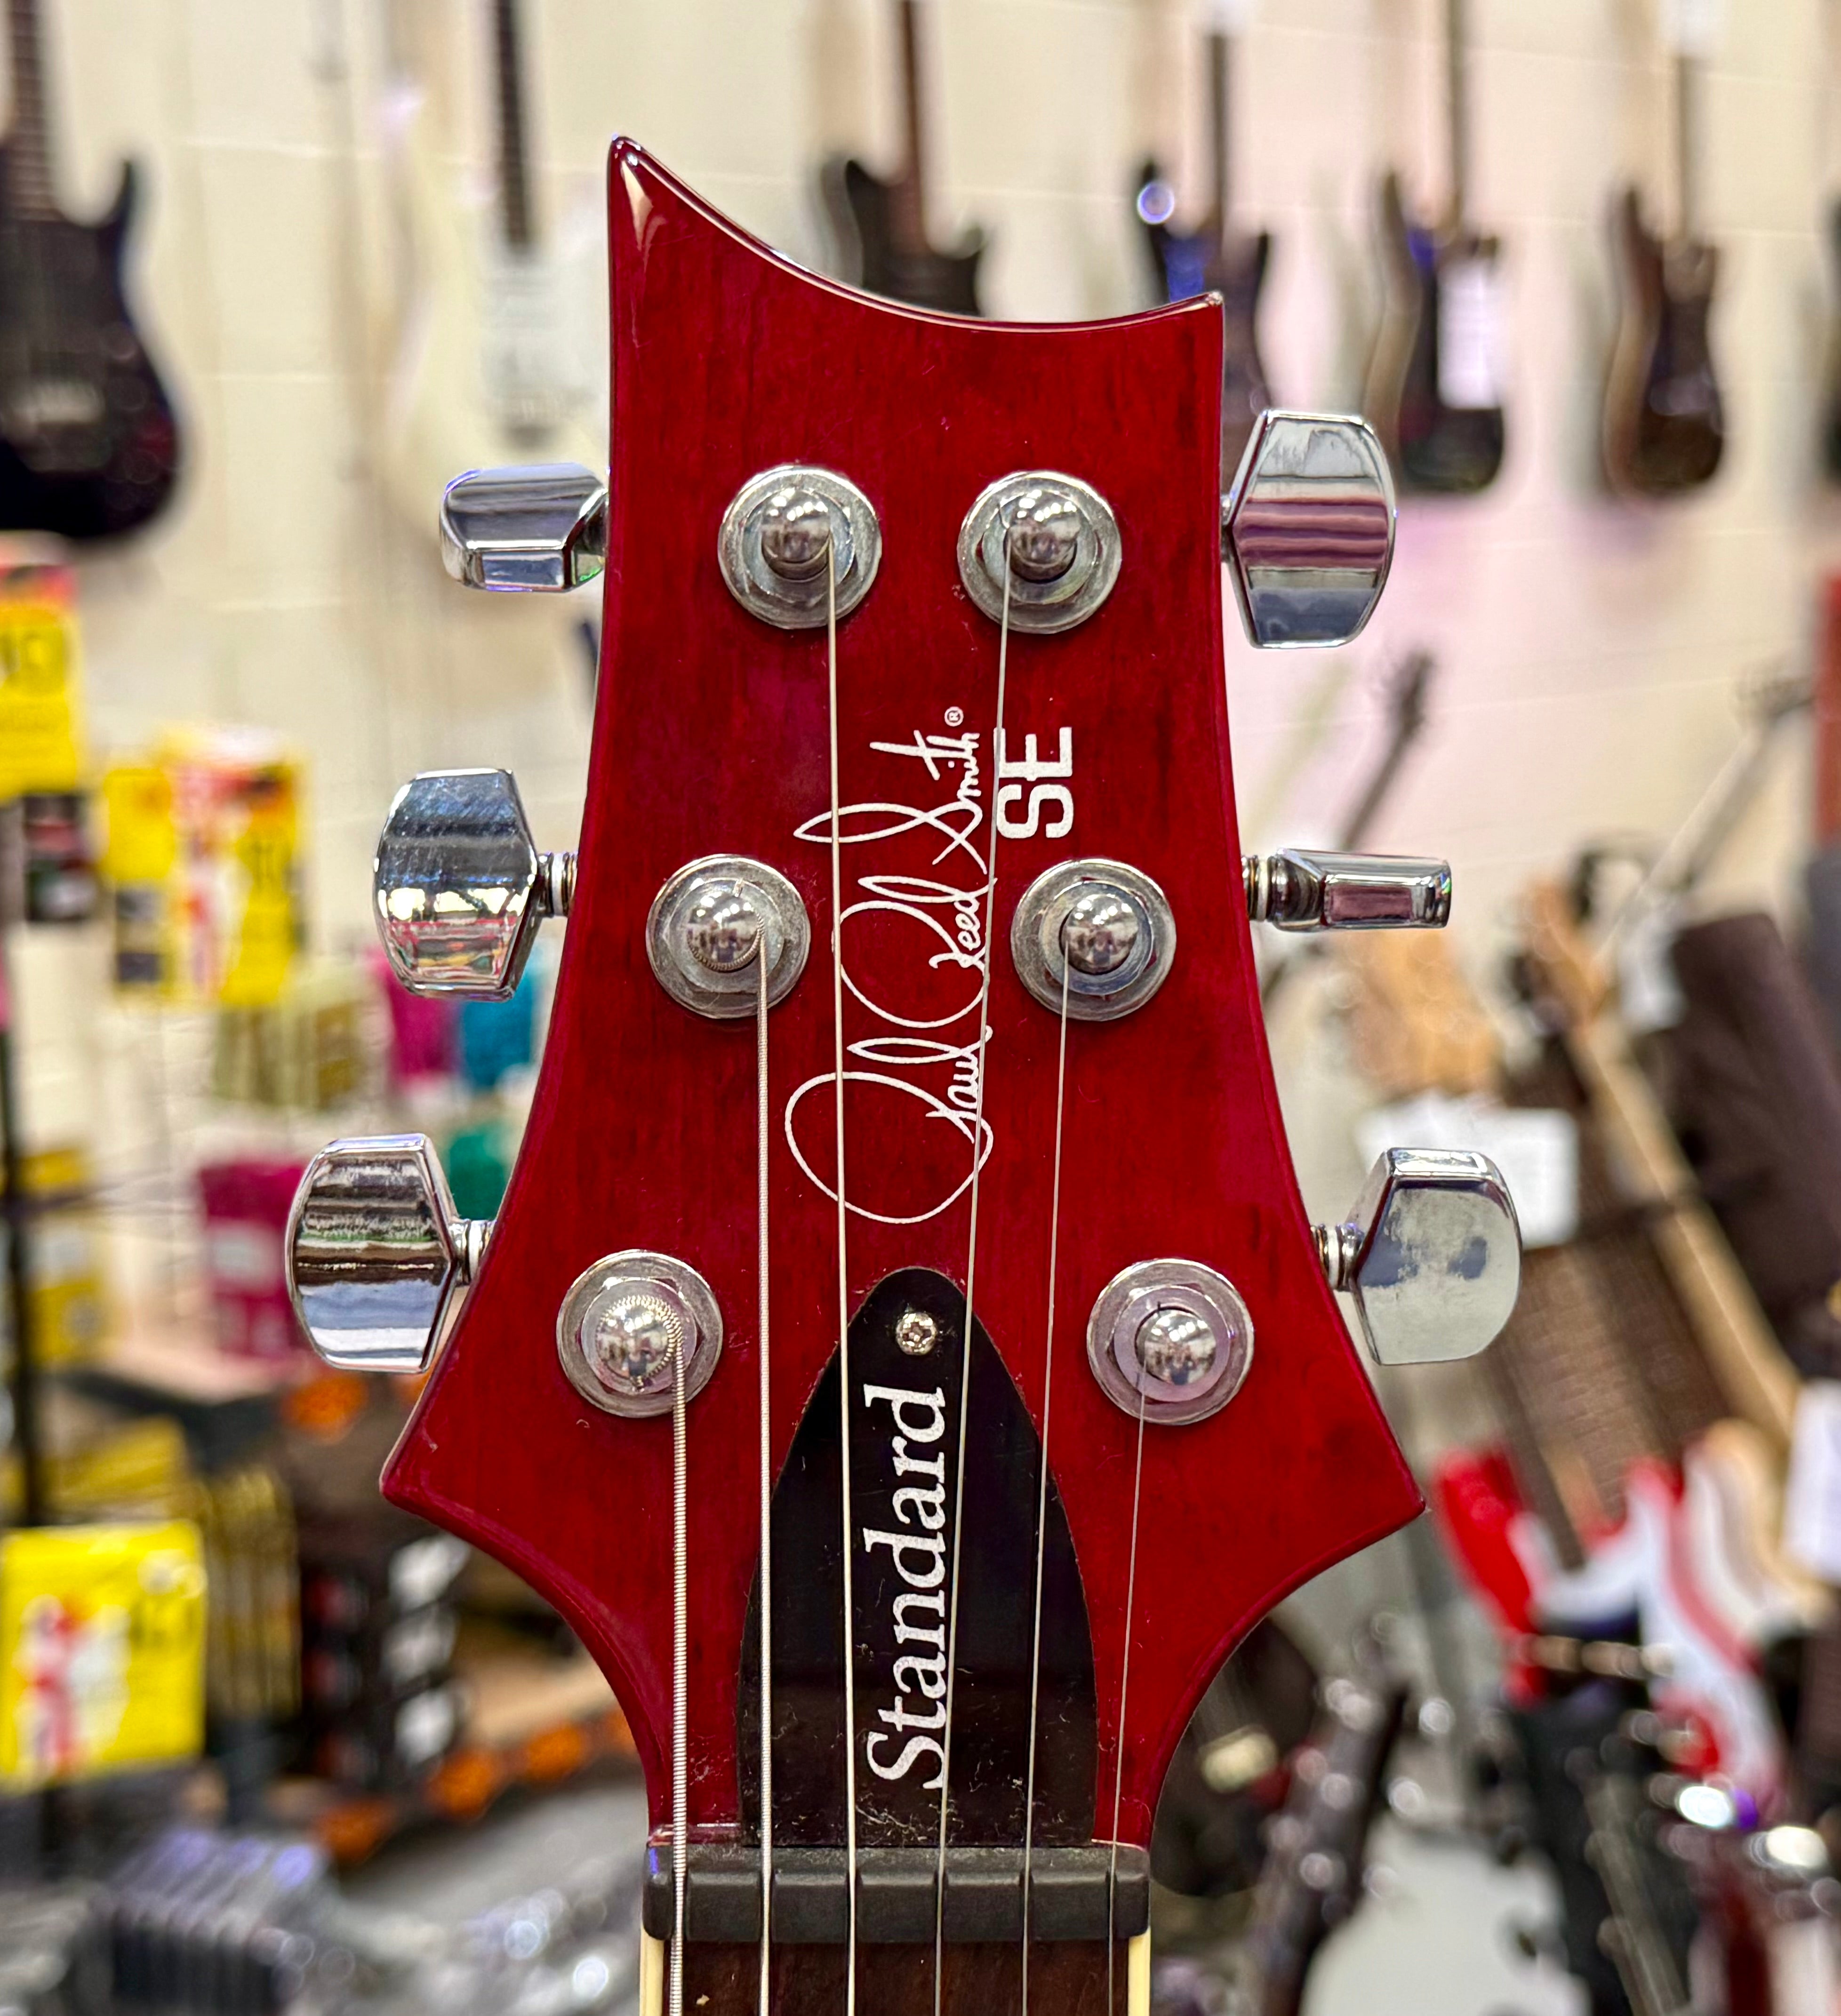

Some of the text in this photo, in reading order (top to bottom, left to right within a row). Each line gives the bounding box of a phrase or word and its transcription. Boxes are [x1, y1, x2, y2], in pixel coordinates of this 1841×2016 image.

[993, 727, 1074, 839] SE
[832, 875, 998, 1028] Reed
[784, 1025, 994, 1224] Paul
[863, 1384, 946, 1790] Standard
